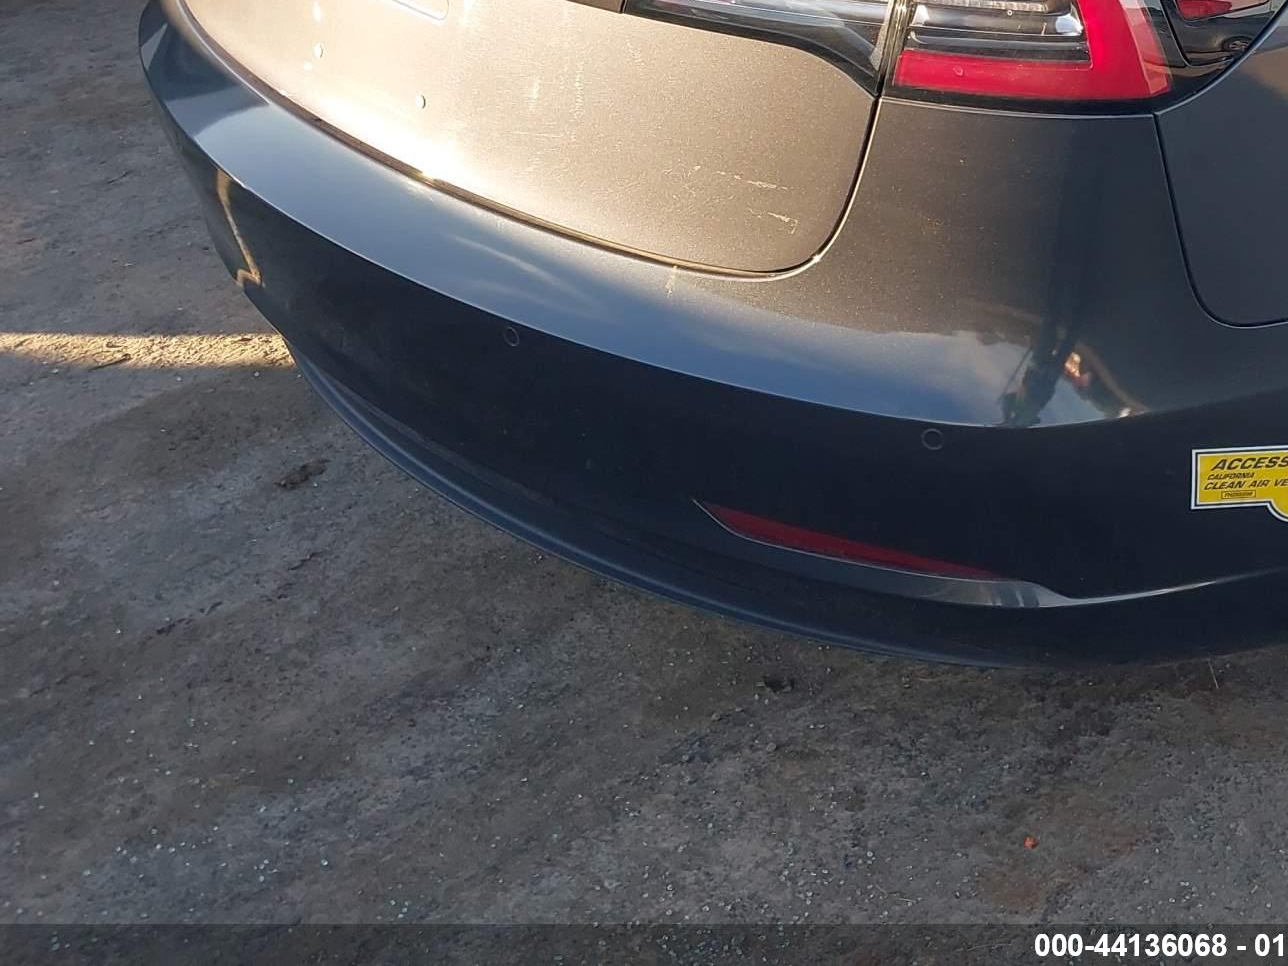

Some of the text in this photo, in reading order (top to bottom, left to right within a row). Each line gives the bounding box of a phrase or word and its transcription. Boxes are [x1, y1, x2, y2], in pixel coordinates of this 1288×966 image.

[1207, 472, 1255, 481] CALIFORNIA
[1204, 480, 1246, 491] CLEAN
[1250, 479, 1271, 487] AIR
